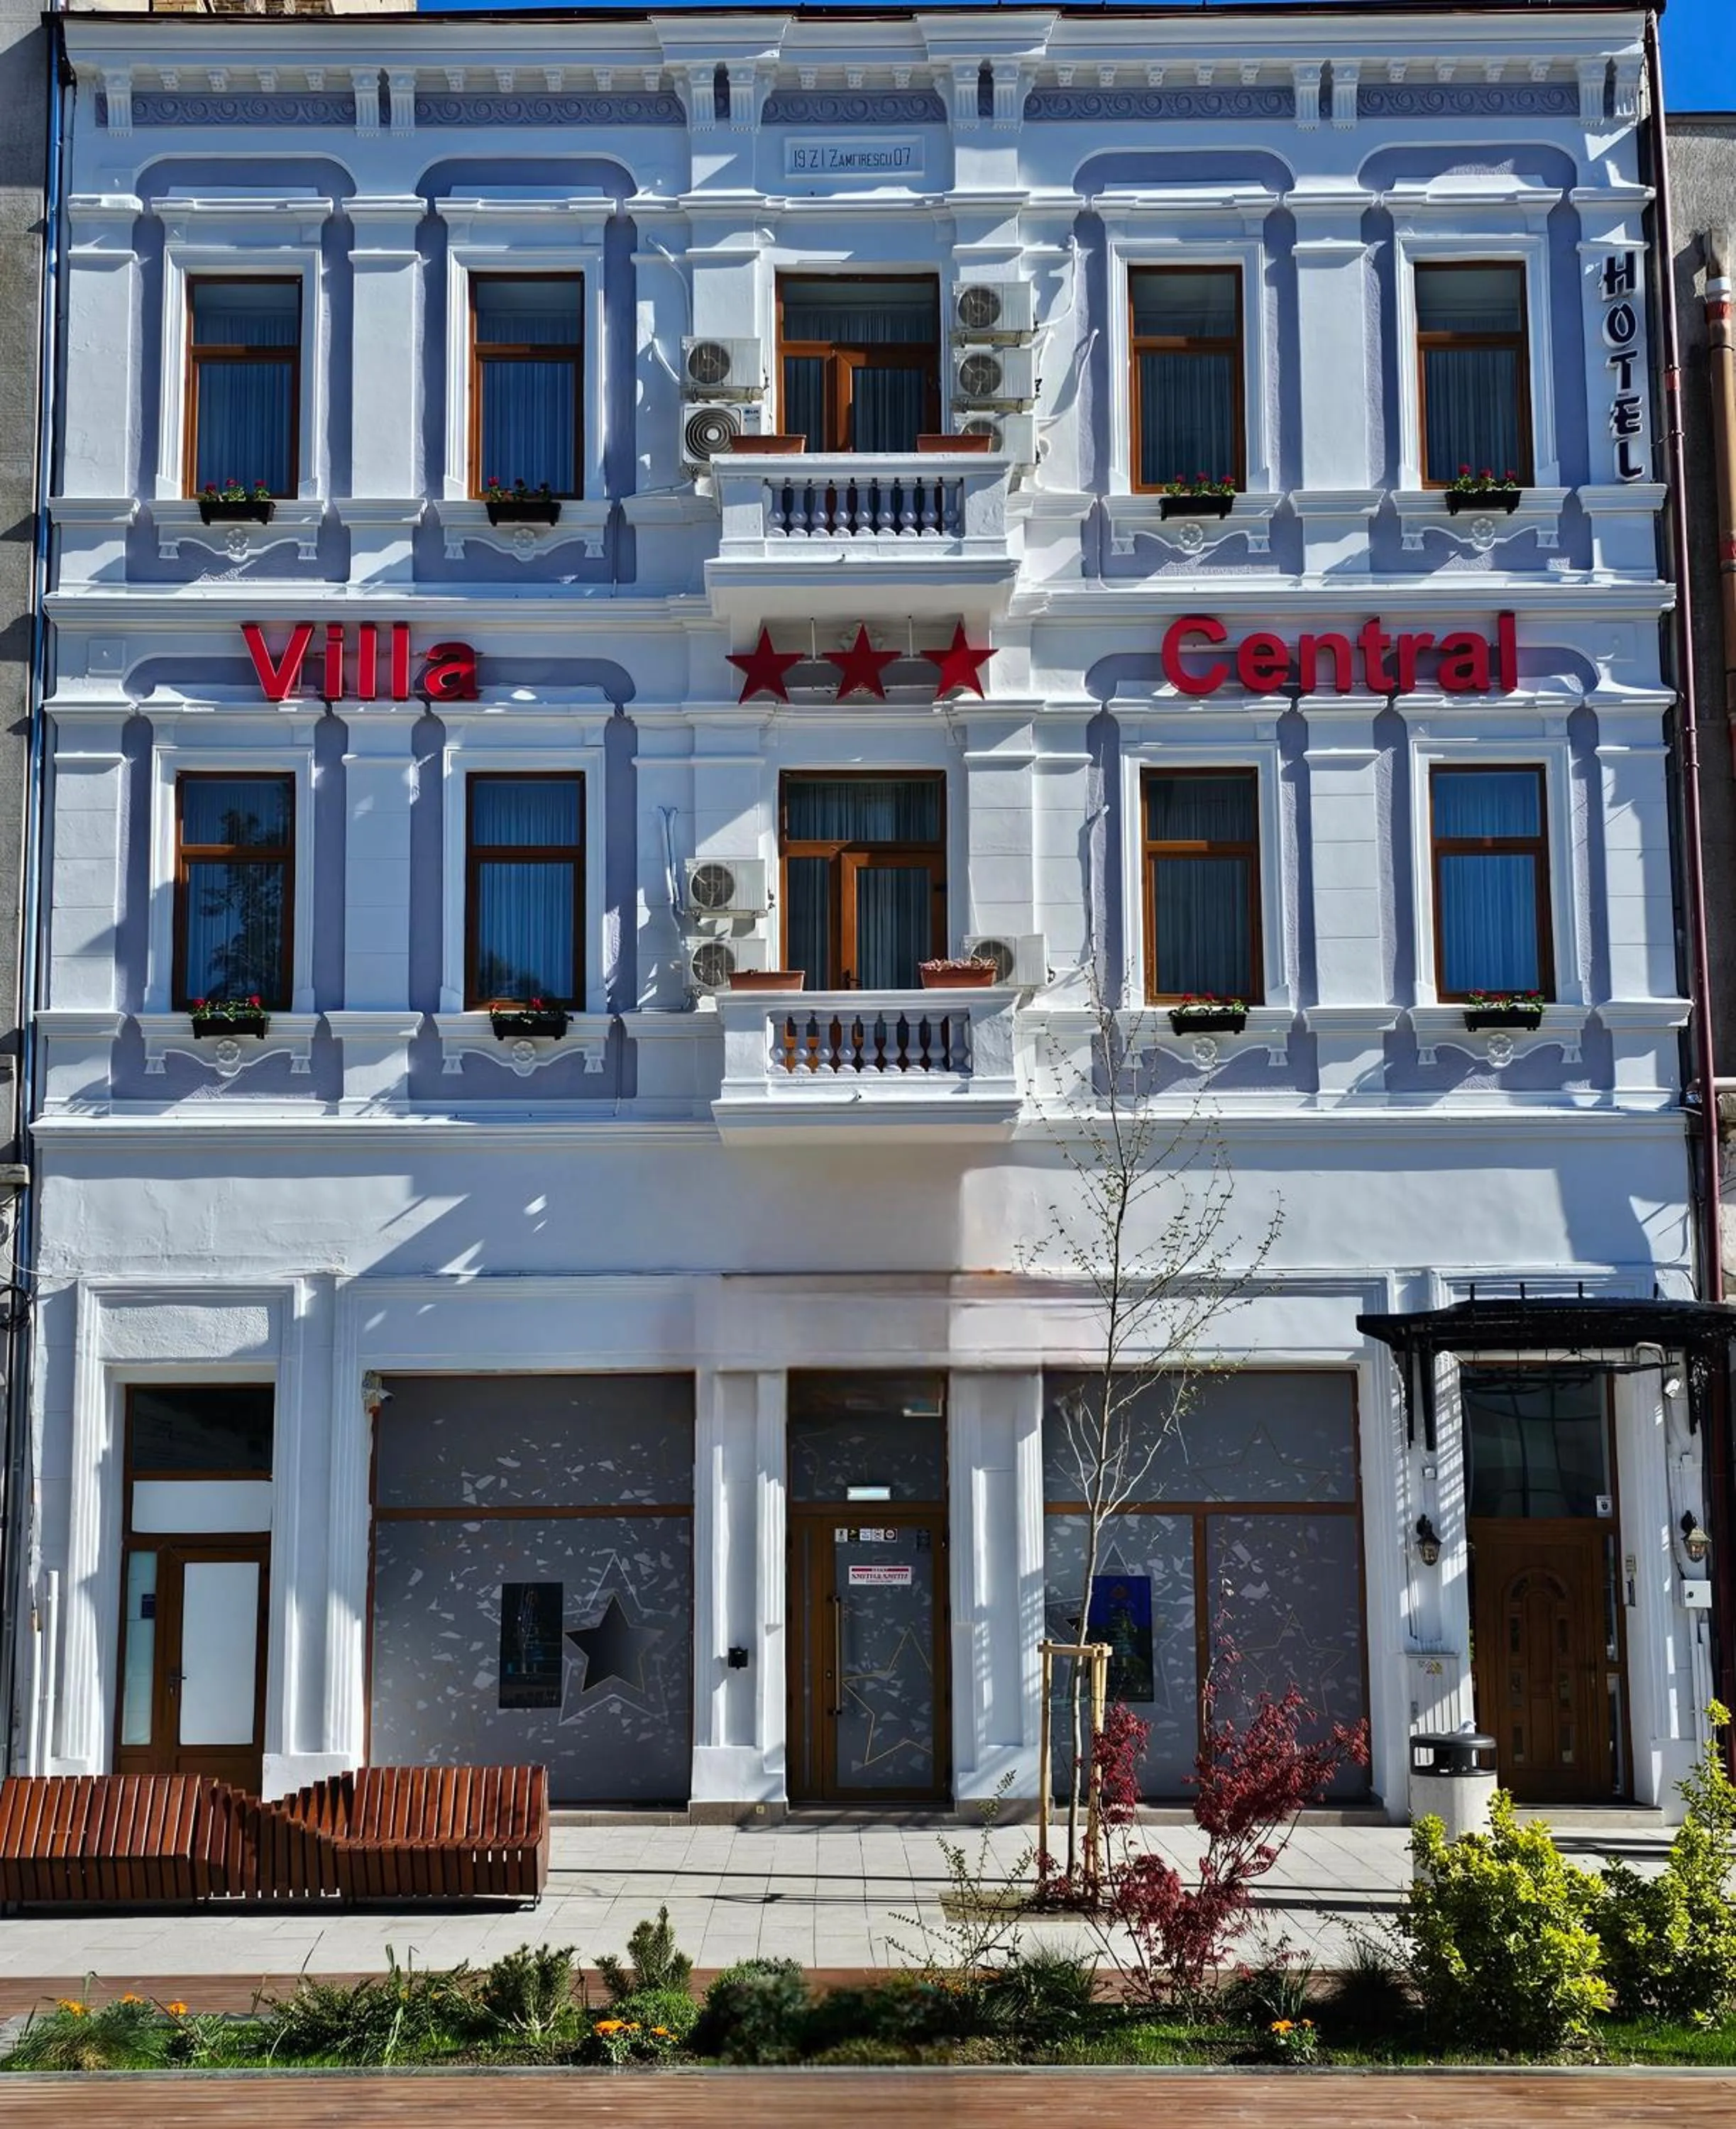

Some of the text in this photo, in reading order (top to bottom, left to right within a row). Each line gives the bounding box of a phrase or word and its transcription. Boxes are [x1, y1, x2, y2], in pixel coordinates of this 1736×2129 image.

[1601, 251, 1644, 482] HOTEL
[240, 610, 1518, 702] Villa Central
